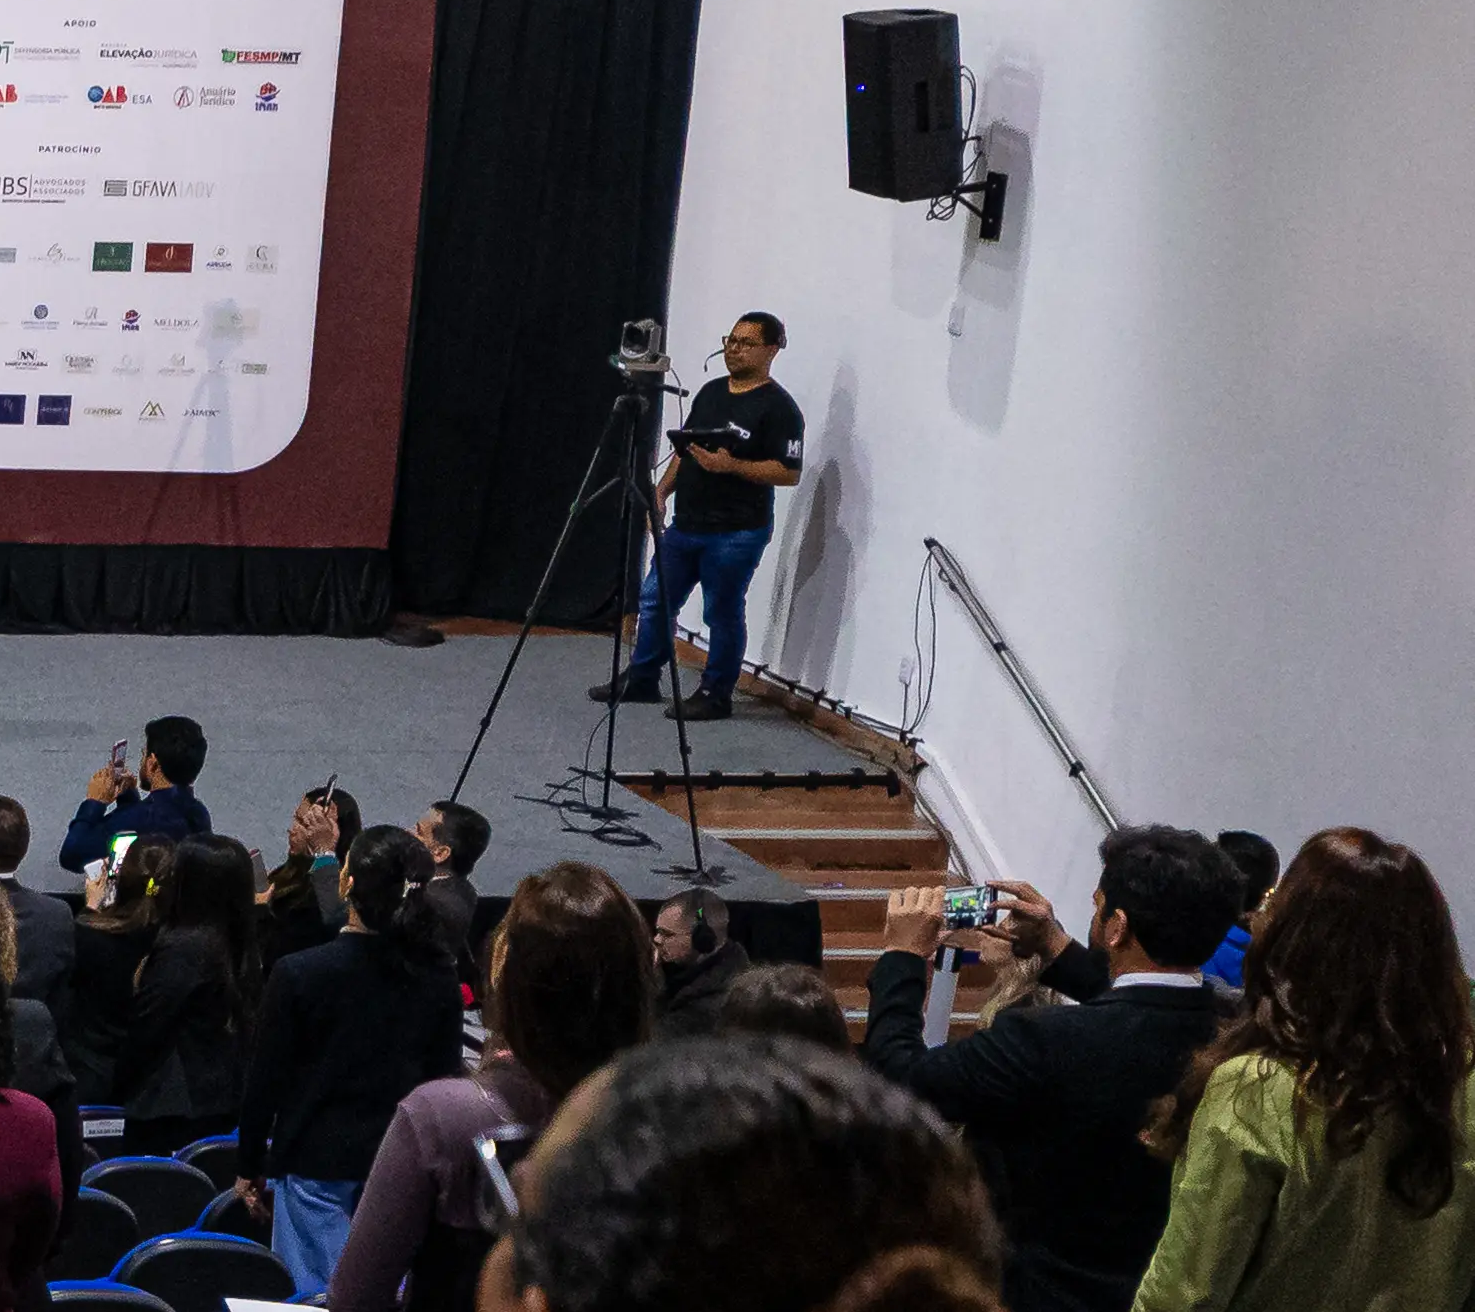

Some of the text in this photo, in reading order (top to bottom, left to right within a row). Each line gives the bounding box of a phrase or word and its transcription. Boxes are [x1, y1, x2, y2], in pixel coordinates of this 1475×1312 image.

[63, 19, 97, 28] APOIO
[100, 48, 153, 60] ELEVAÇÃO
[237, 50, 301, 64] FESMP/MT
[199, 86, 236, 97] Anuário
[132, 94, 153, 105] ESA
[199, 95, 236, 107] Jurídico
[38, 144, 102, 155] PATROCÍNIO
[33, 178, 87, 187] ADVOGADOS
[33, 187, 86, 196] ASSOCIADOS
